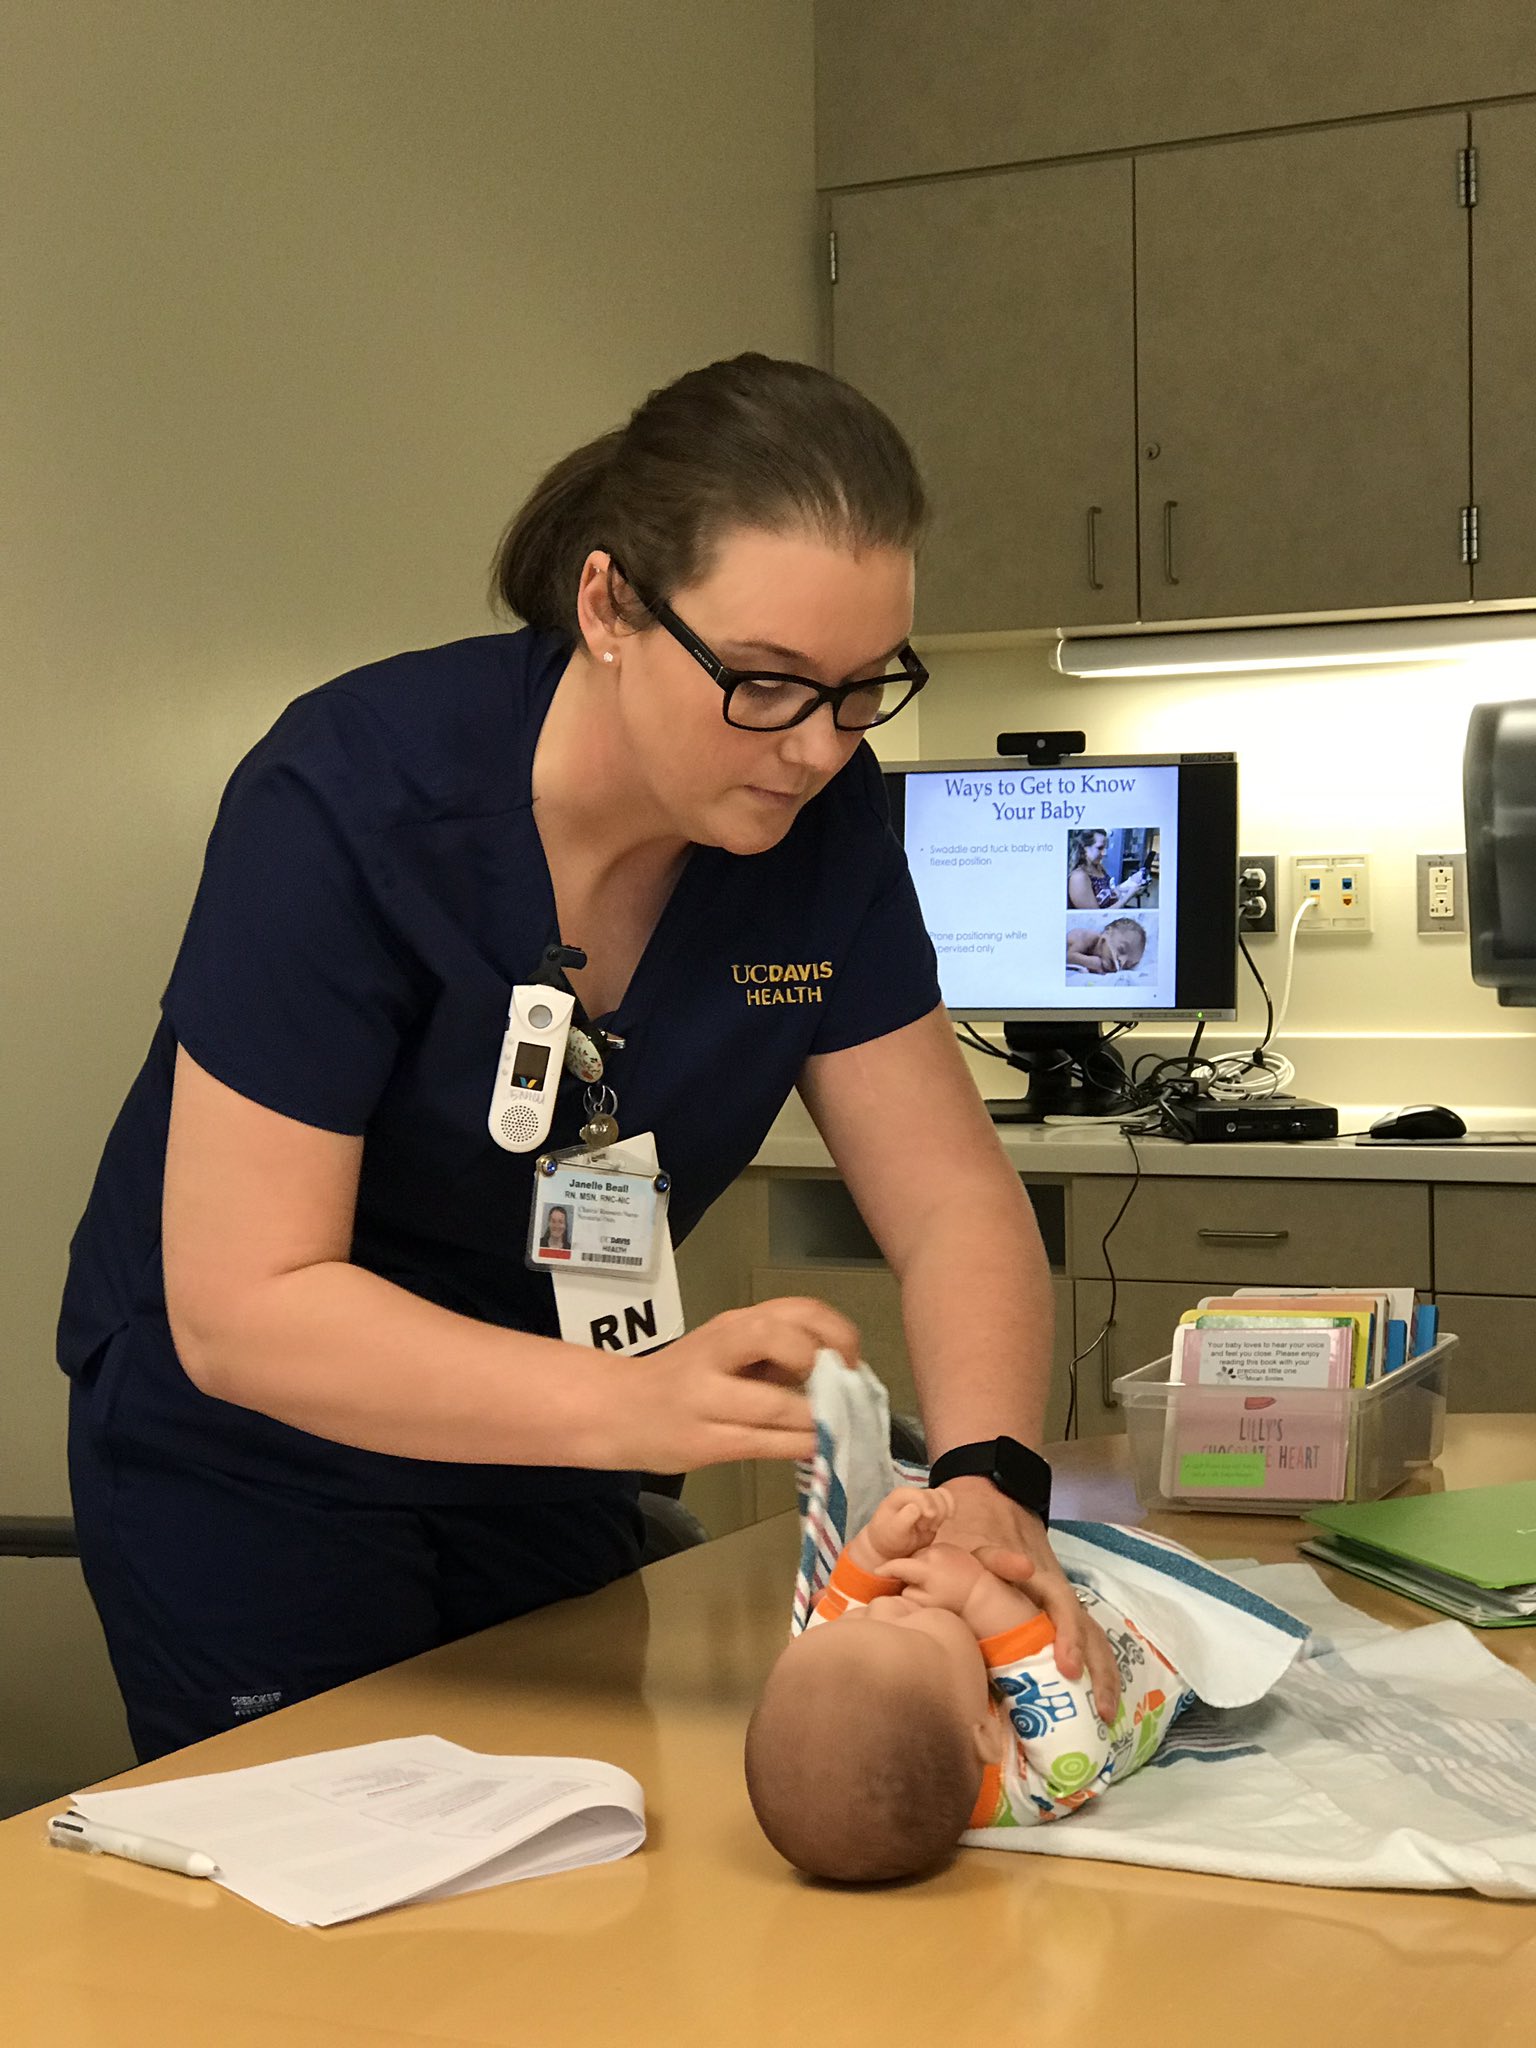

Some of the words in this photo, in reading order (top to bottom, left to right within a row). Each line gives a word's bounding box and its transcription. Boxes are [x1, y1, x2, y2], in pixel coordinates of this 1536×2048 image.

[945, 778, 993, 802] Ways
[998, 779, 1016, 795] to
[1020, 776, 1052, 795] Get
[1058, 777, 1076, 794] to
[1080, 774, 1137, 793] Know
[992, 801, 1035, 821] Your
[1041, 800, 1086, 825] Baby
[930, 844, 968, 854] Swaddle
[970, 844, 988, 853] and
[990, 844, 1009, 853] tuck
[1011, 843, 1035, 854] baby
[1037, 843, 1053, 852] into
[930, 857, 957, 866] flexed
[959, 856, 992, 867] position
[956, 931, 1003, 942] positioning
[1005, 931, 1028, 940] while
[976, 944, 995, 954] only
[746, 986, 822, 1006] HEALTH
[569, 1179, 603, 1190] Janelle
[590, 1299, 657, 1351] RN
[1240, 1417, 1283, 1442] LILLY'S
[1279, 1445, 1320, 1470] HEART
